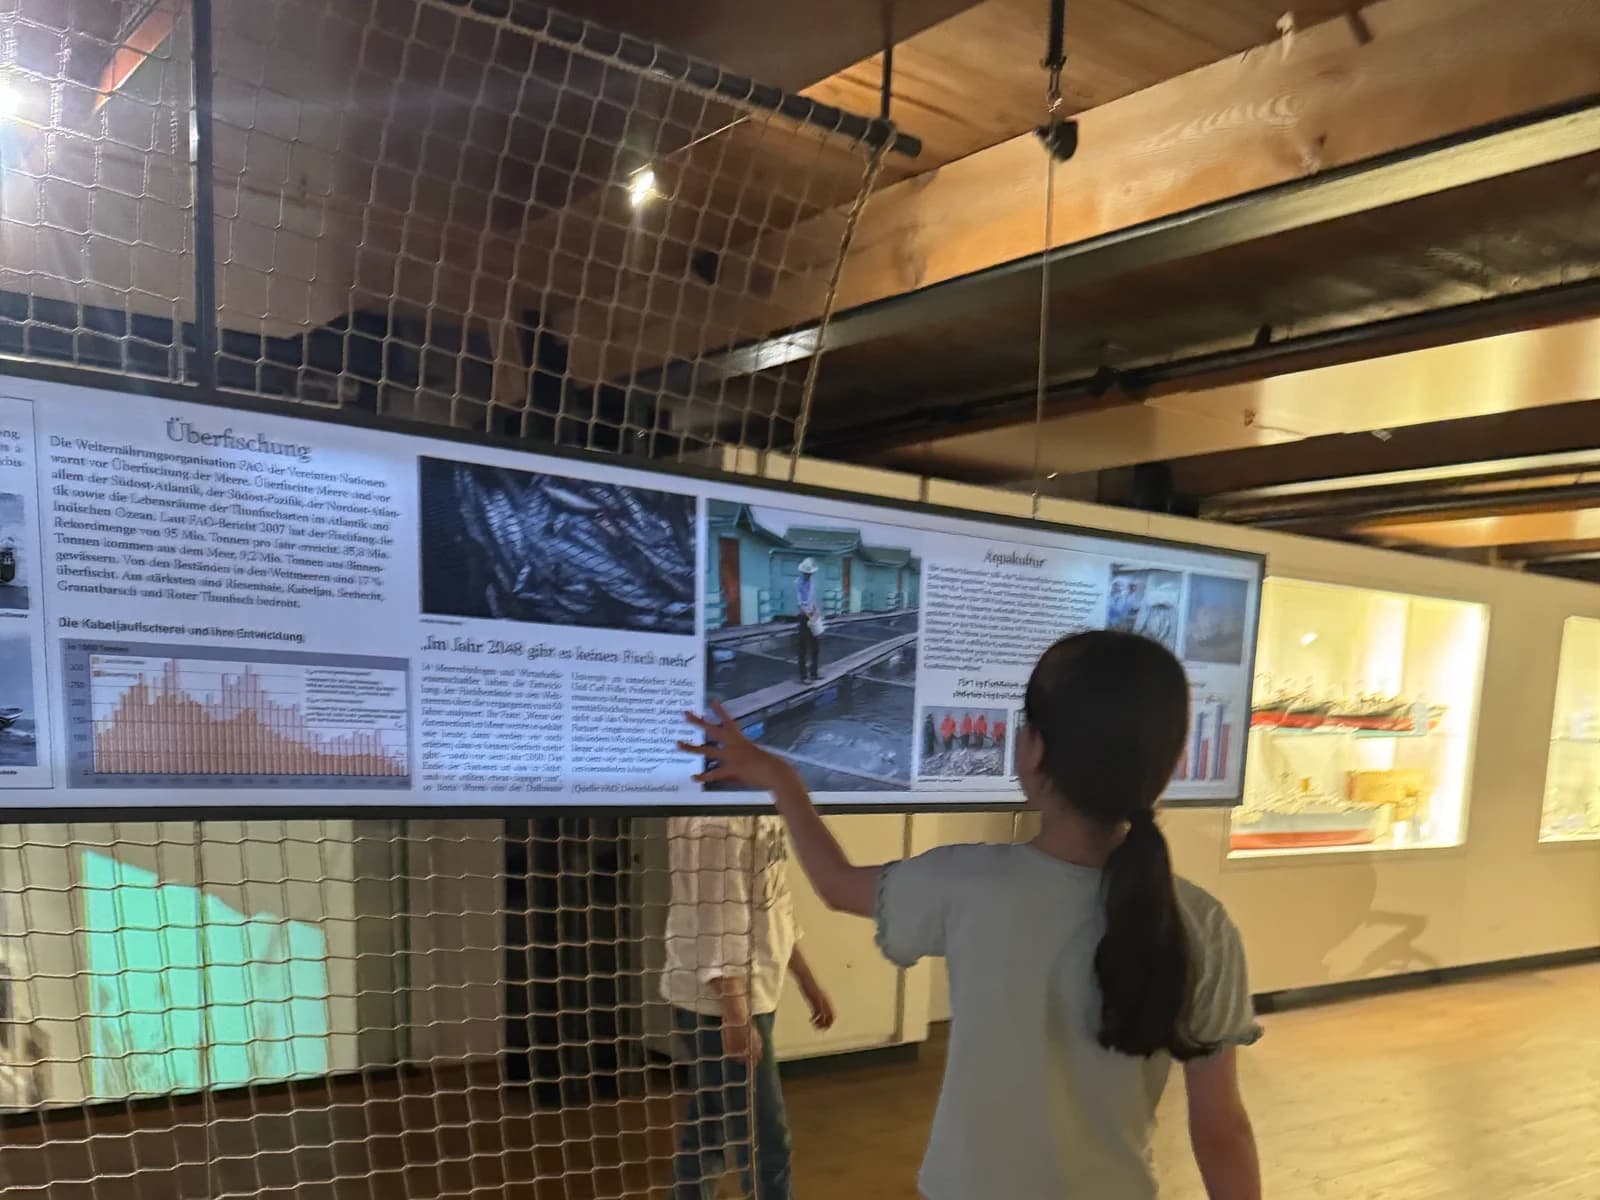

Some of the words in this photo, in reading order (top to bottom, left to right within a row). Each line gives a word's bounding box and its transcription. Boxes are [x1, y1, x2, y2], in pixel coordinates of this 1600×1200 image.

[50, 435, 72, 448] Die
[240, 460, 263, 472] FAO
[268, 464, 285, 475] der
[165, 417, 312, 463] Überfischung
[51, 456, 85, 466] warnt
[90, 461, 108, 469] vor
[112, 459, 189, 481] Überfischung
[192, 471, 210, 481] der
[51, 469, 84, 482] allem
[87, 473, 108, 484] der
[206, 486, 224, 498] der
[308, 498, 325, 509] der
[52, 485, 69, 496] tik
[73, 489, 105, 500] sowie
[109, 491, 128, 502] die
[132, 493, 207, 511] Lebensräume
[210, 502, 228, 513] der
[312, 513, 325, 524] im
[328, 515, 368, 529] Atlantik
[54, 501, 111, 516] Indischen
[160, 512, 186, 524] Laut
[260, 522, 285, 534] 2007
[308, 527, 326, 538] der
[54, 517, 137, 537] Rekordmenge
[140, 528, 160, 537] von
[165, 528, 179, 538] 95
[208, 532, 249, 545] Tonnen
[253, 539, 271, 549] pro
[274, 539, 297, 550] Jahr
[54, 533, 100, 546] Tonnen
[104, 537, 155, 551] kommen
[158, 545, 177, 553] aus
[180, 545, 203, 556] dem
[285, 555, 323, 567] Tonnen
[121, 569, 143, 581] Am
[146, 572, 196, 585] stärksten
[122, 555, 148, 567] Von
[151, 558, 171, 569] den
[174, 560, 231, 573] Beständen
[234, 564, 244, 574] in
[247, 565, 267, 576] den
[57, 580, 138, 596] Granatbarsch
[141, 588, 163, 598] und
[167, 589, 198, 600] Roter
[59, 616, 80, 627] Die
[82, 618, 186, 635] Kabeljaufischerei
[189, 626, 209, 636] und
[212, 627, 235, 638] ihre
[450, 637, 483, 653] Jahr
[487, 639, 522, 656] 2048
[559, 648, 572, 659] es
[575, 645, 618, 662] keinen
